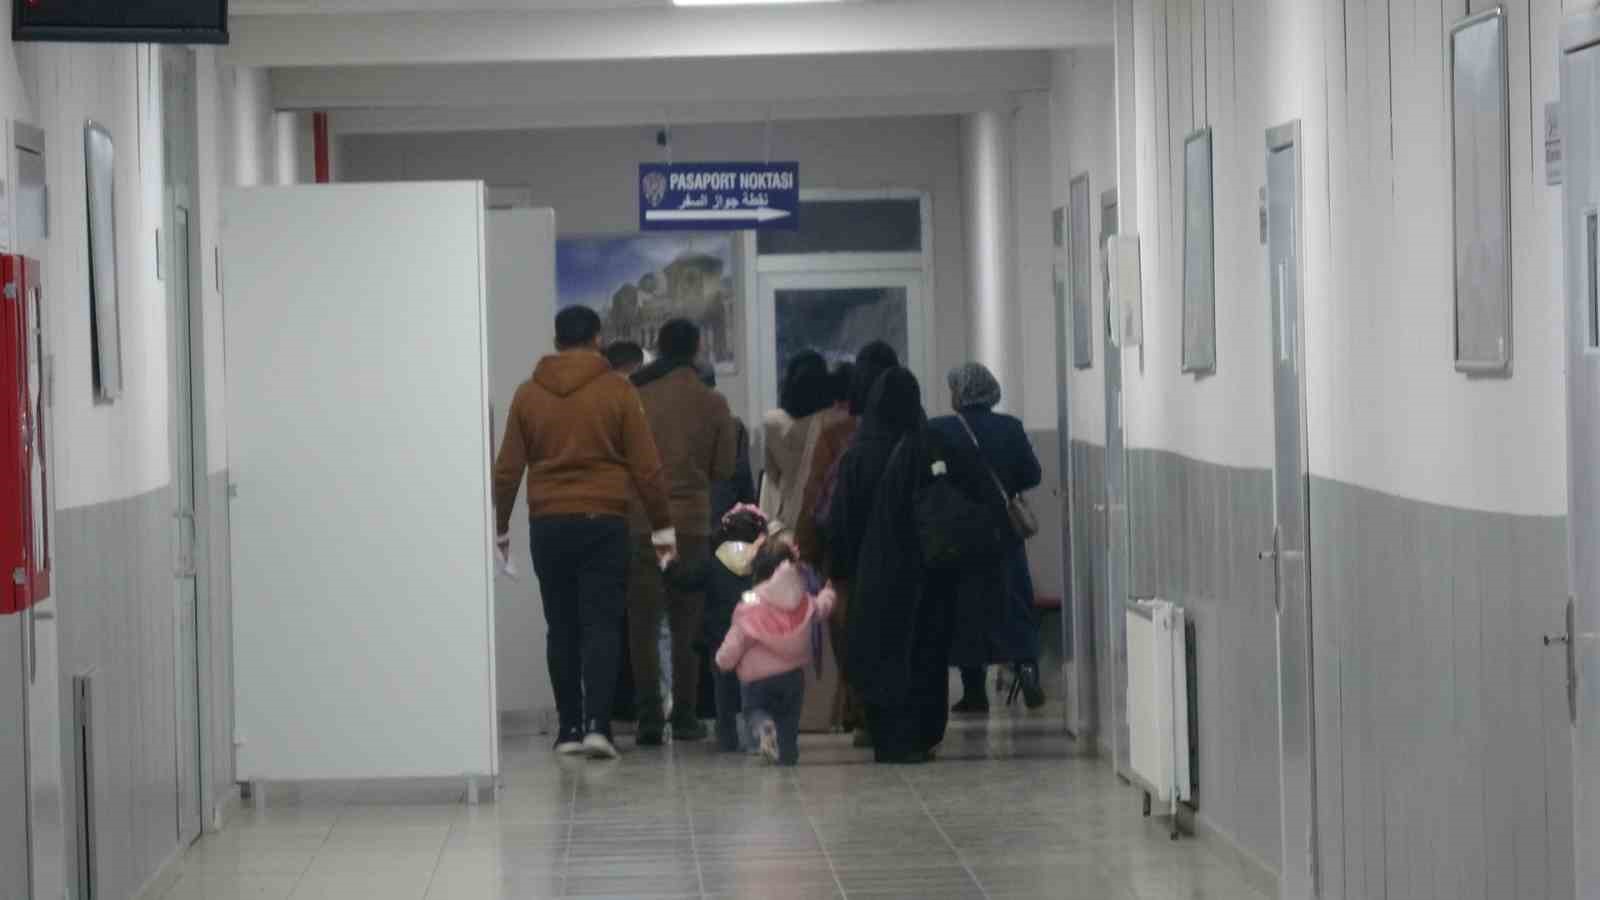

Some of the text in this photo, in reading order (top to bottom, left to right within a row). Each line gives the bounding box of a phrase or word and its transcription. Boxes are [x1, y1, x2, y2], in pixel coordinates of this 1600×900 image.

[670, 171, 794, 190] PASAPORT NOKTASI
[680, 192, 769, 209] نقطة جواز السفر
